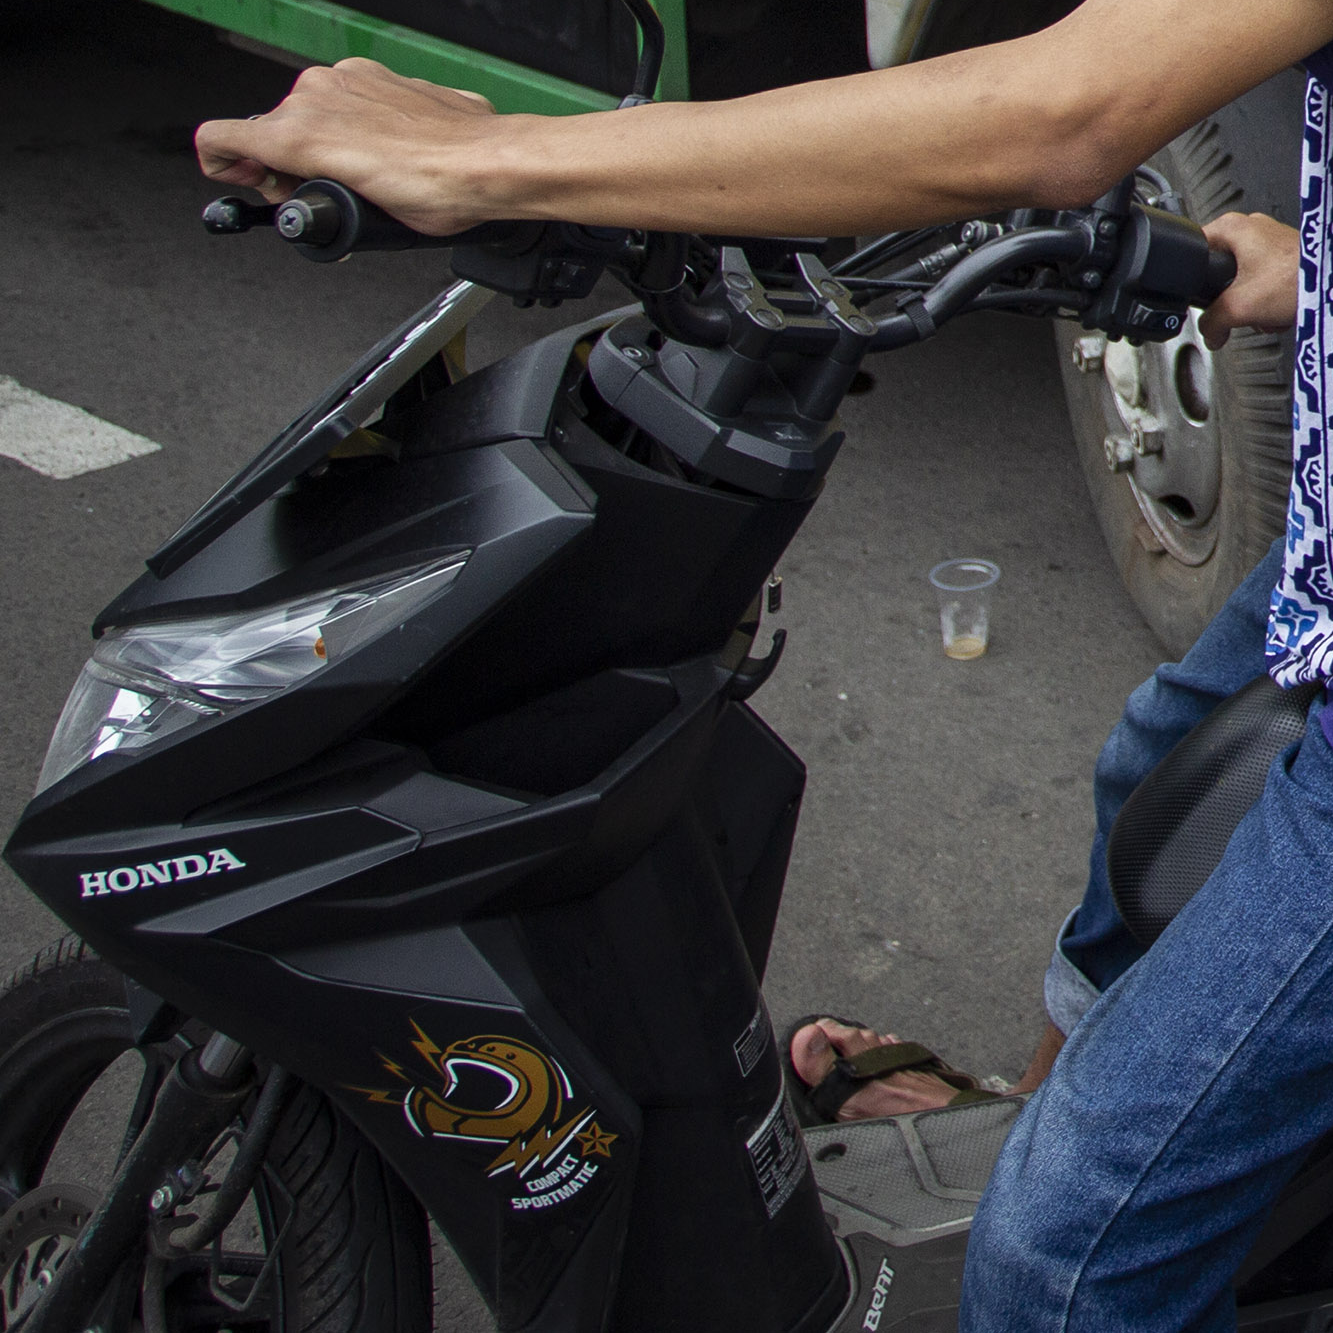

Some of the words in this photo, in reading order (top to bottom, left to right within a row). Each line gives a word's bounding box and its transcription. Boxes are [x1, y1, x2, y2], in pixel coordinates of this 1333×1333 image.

[81, 848, 246, 898] HONDA
[511, 1161, 599, 1209] SPORTMATIC
[526, 1153, 579, 1192] COMPACT
